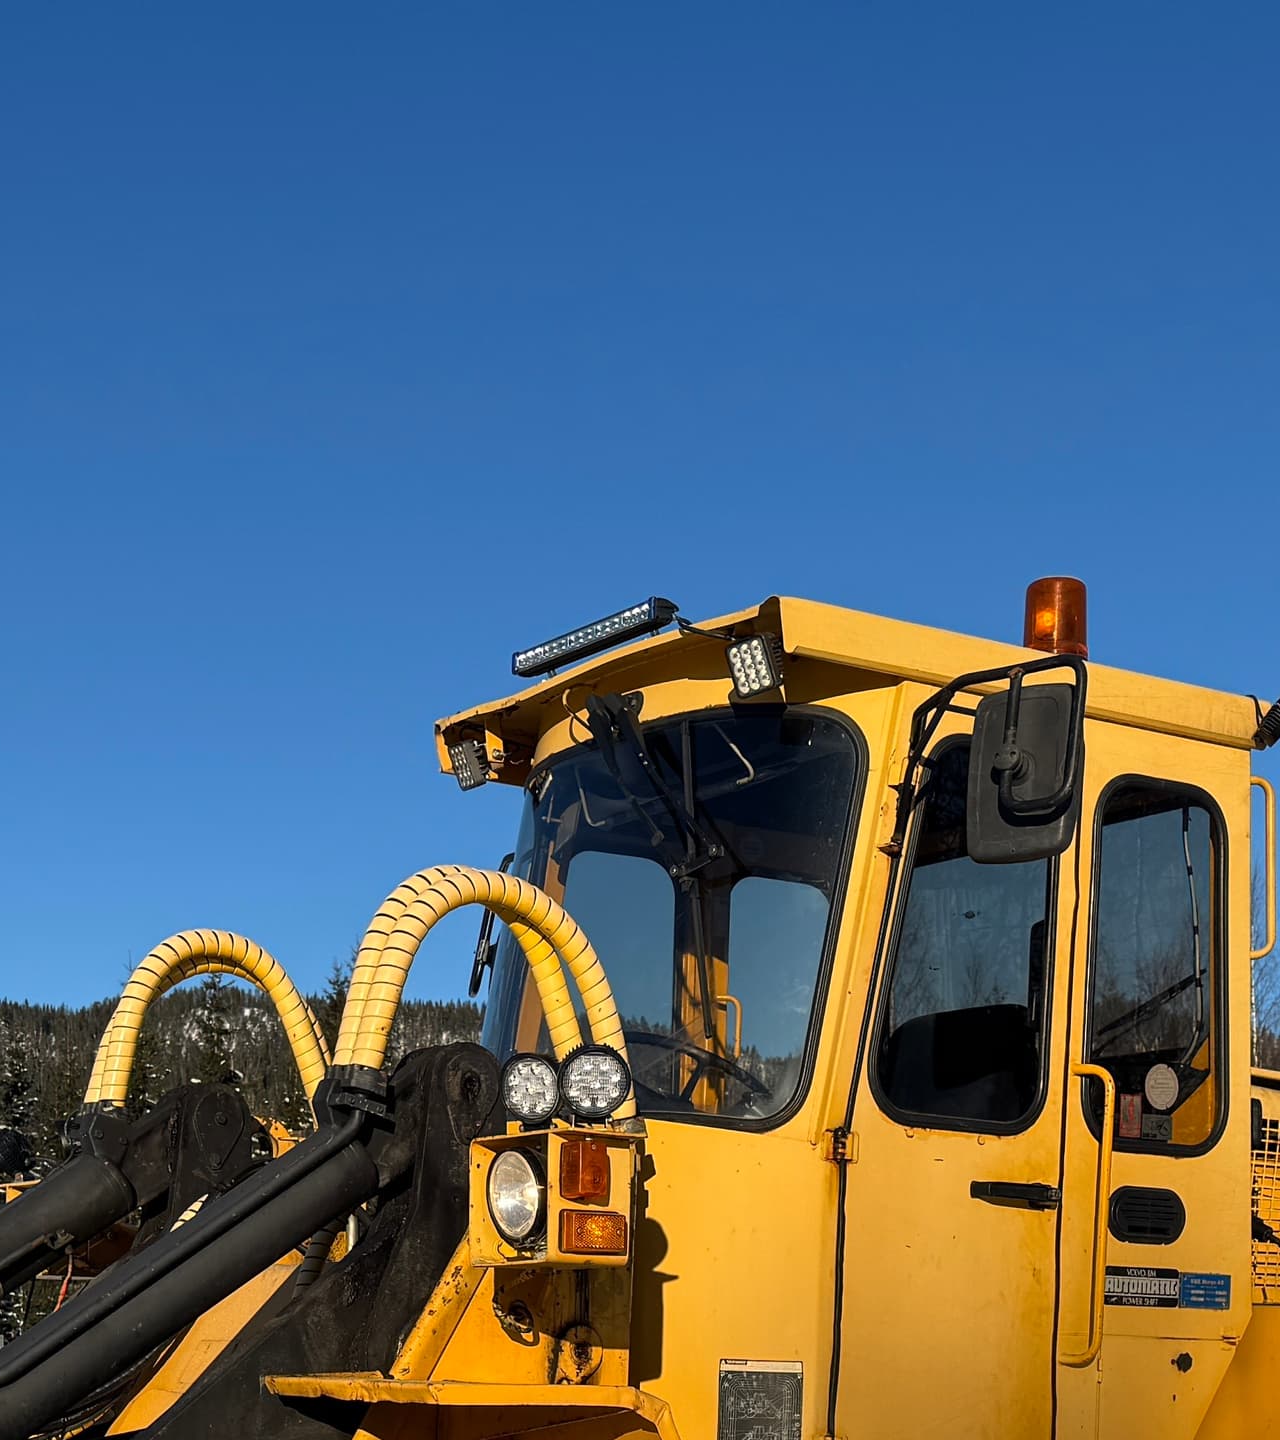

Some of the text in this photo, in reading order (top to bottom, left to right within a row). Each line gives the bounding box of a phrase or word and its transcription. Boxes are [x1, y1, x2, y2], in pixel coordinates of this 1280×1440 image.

[1105, 1279, 1178, 1295] AUTOMATIC
[1123, 1298, 1159, 1306] POWER SHIFT
